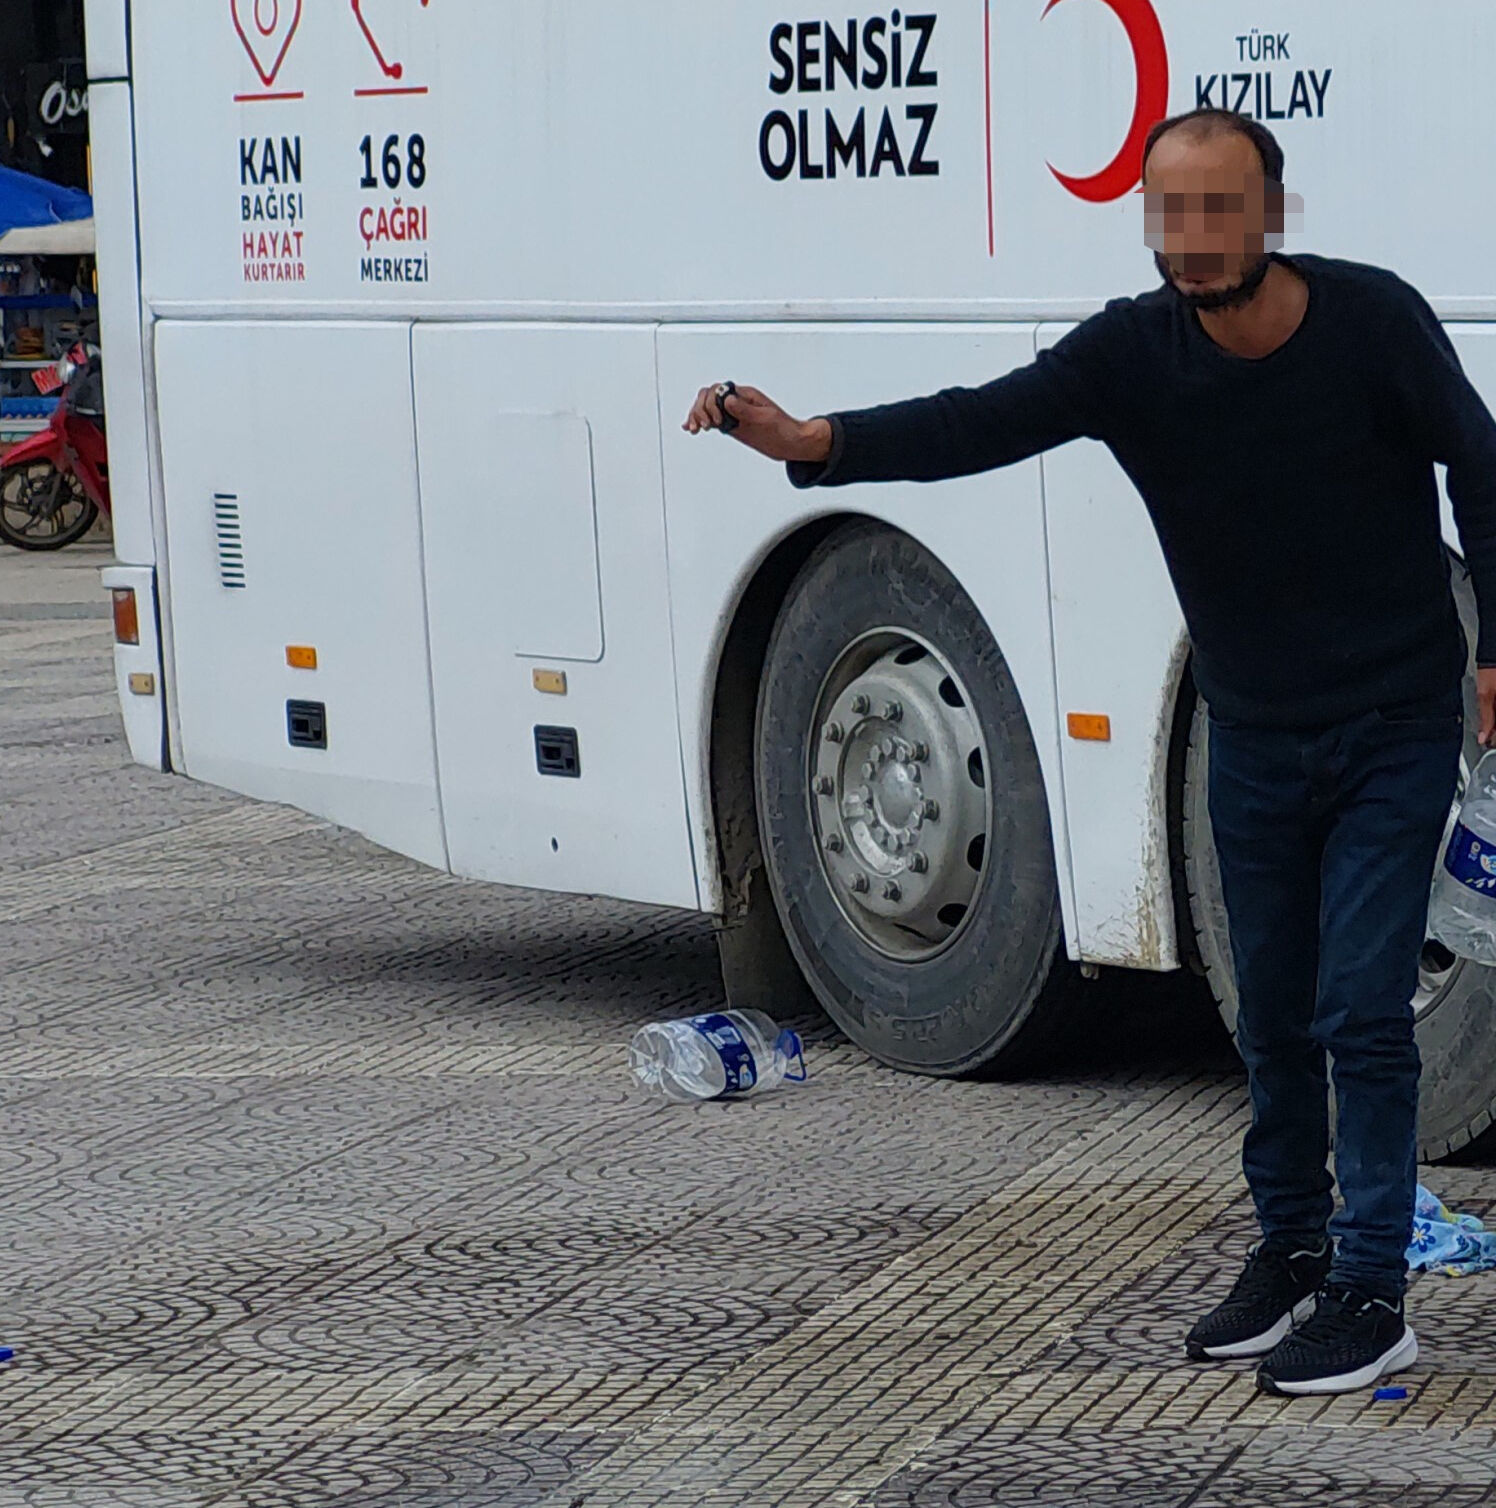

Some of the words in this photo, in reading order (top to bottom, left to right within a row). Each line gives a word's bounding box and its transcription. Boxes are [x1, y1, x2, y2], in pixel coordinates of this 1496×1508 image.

[1235, 28, 1291, 62] TÜRK
[1195, 68, 1333, 120] KIZILAY
[239, 135, 302, 186] KAN
[359, 133, 427, 190] 168
[758, 102, 940, 182] OLMAZ
[241, 186, 303, 228] BAĞIŞI
[359, 197, 428, 251] ÇAĞRI
[242, 231, 304, 259] HAYAT
[360, 252, 429, 282] MERKEZİ
[243, 262, 305, 282] KURTARIR
